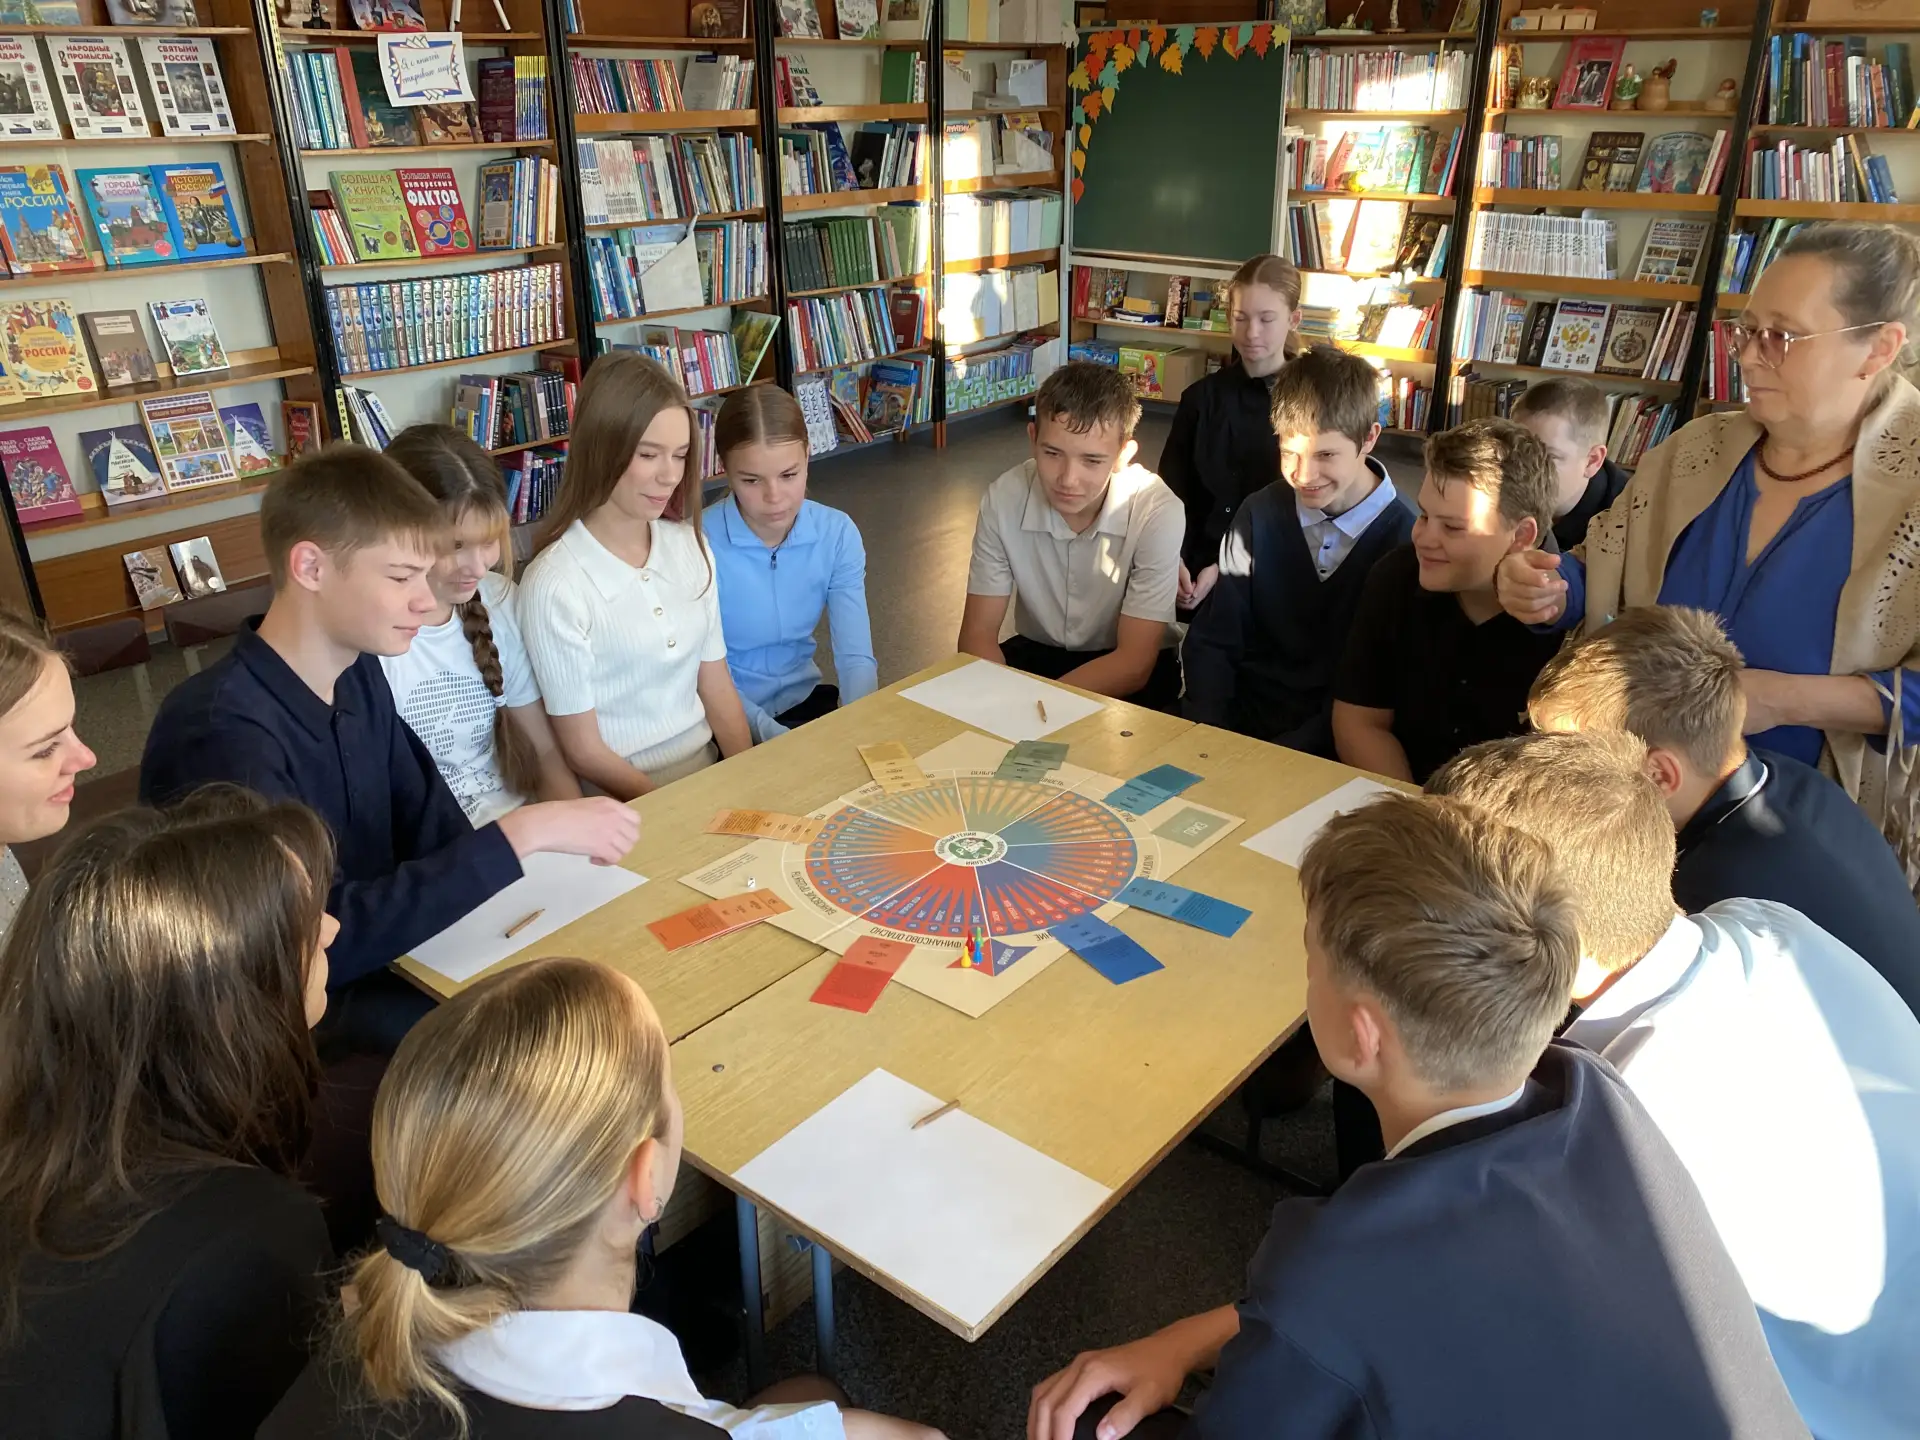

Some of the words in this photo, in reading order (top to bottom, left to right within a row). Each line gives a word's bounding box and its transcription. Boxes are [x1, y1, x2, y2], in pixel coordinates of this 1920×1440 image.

[158, 45, 199, 53] СВЯТЫНИ
[162, 54, 198, 62] РОССИИ
[790, 67, 809, 75] ТНЫХ
[170, 176, 212, 184] ИСТОРИЯ
[340, 174, 393, 184] БОЛЬШАЯ
[400, 170, 430, 180] Большая
[104, 181, 140, 189] ГОРОДА
[175, 182, 212, 191] РОССИИ
[353, 185, 386, 195] КНИГА
[404, 181, 453, 189] интересных
[106, 188, 140, 197] РОССИИ
[406, 189, 460, 206] ФАКТОВ
[4, 195, 64, 209] РОССИИ
[1616, 316, 1655, 328] РОССИИ
[24, 346, 67, 358] РОССИИ
[1183, 821, 1208, 838] ПРИЗ
[870, 926, 905, 940] ОПАСНО
[905, 934, 962, 948] ФИНАНСОВО
